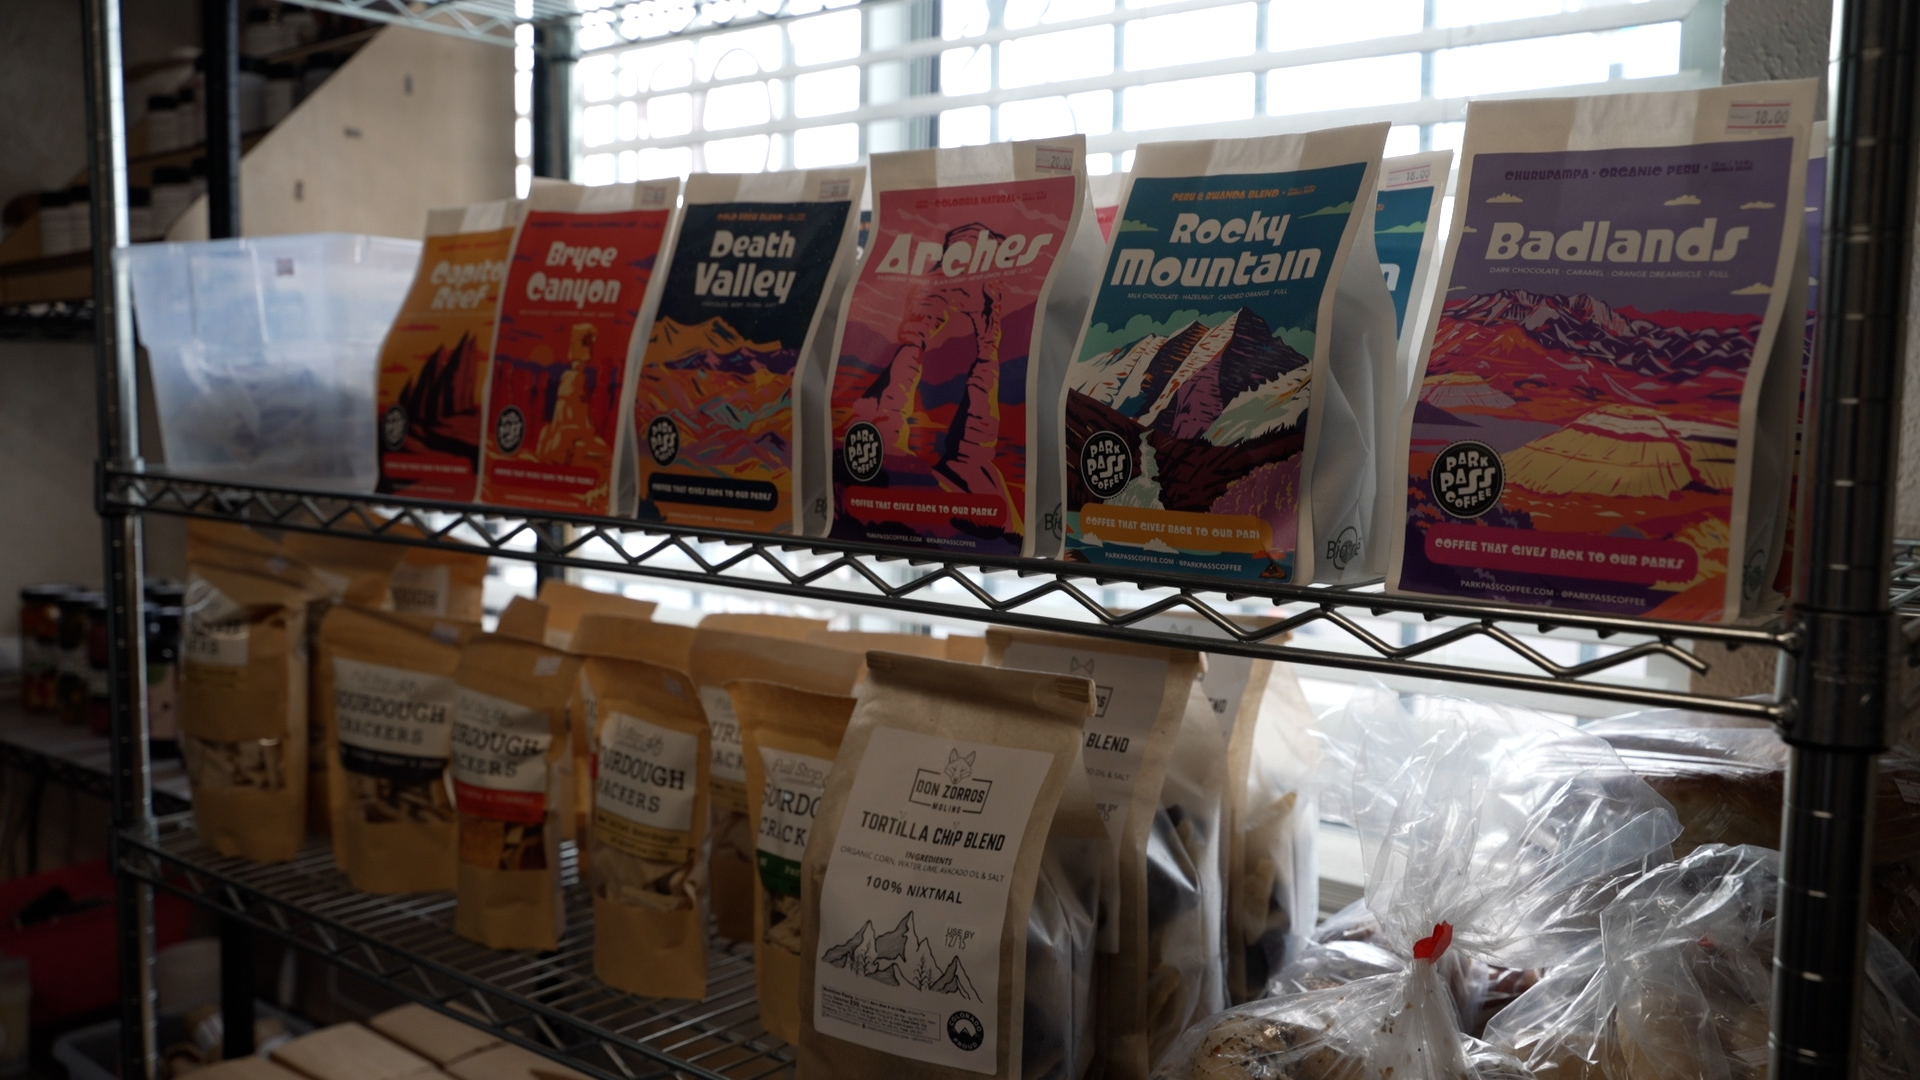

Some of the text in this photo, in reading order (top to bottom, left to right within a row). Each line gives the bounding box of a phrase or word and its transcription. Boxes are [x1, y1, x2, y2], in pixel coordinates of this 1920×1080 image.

[1754, 110, 1789, 124] 18.00
[1406, 169, 1430, 181] 18.00
[1505, 163, 1700, 181] CHURUPAMPA ORGANIC PERU
[1172, 192, 1196, 201] PERU
[1205, 190, 1246, 200] RWANDA
[1248, 188, 1279, 199] BLEND
[1169, 210, 1291, 247] Rocky
[709, 229, 797, 258] Death
[1485, 218, 1750, 263] Badlands
[545, 240, 618, 274] Bryce
[875, 230, 1054, 277] Arches
[430, 259, 503, 288] Capito
[1110, 248, 1322, 287] Mountain
[1489, 266, 1729, 279] DARK CHOCOLATE CARAMEL ORANGE DREAMSICLE FULL
[526, 271, 622, 310] Canyon
[694, 262, 797, 305] Valley
[1142, 292, 1178, 300] CHOCOLATE
[1218, 292, 1244, 300] CANDIED
[1244, 289, 1269, 298] ORANGE
[430, 284, 491, 310] Reef
[850, 429, 875, 446] PARK
[1090, 439, 1121, 458] PARK
[848, 441, 879, 464] PASS
[1446, 450, 1489, 471] PARK
[851, 457, 878, 475] COFFEE
[1086, 453, 1126, 479] PASS
[1091, 471, 1124, 490] COFFEE
[1440, 466, 1496, 495] PASS
[851, 498, 998, 517] COFFEE THAT GIVES BACK TO OUR PARKS
[1445, 487, 1492, 509] COFFEE
[1086, 516, 1116, 528] COFFEE
[1118, 519, 1138, 530] THAT
[1140, 522, 1166, 533] GIVES
[1168, 524, 1193, 536] BACK
[1195, 527, 1208, 537] TO
[1211, 528, 1233, 538] OUR
[1105, 551, 1242, 572] PARKPASSCOFFEE.COM @PARKPASSCOFFEE
[1435, 537, 1685, 570] COFFEE THAT GIVES BACK TO OUR PARKS
[1460, 579, 1646, 607] PARKPASSCOFFEE.COM @PARKPASSCOFFEE
[1086, 732, 1130, 753] BLEND
[916, 779, 985, 803] DON ZORROS
[932, 802, 961, 814] MOLINO
[860, 811, 1006, 851] TORTILLA CHIP BLEND
[840, 844, 873, 860] ORGANIC
[969, 870, 979, 879] OIL
[988, 874, 1005, 883] SALT
[905, 851, 953, 866] INGREDIENTS
[866, 875, 963, 904] 100% NIXTMAL
[947, 927, 975, 940] USE BY
[948, 1012, 982, 1032] COLORADO
[953, 1036, 979, 1050] PROUD
